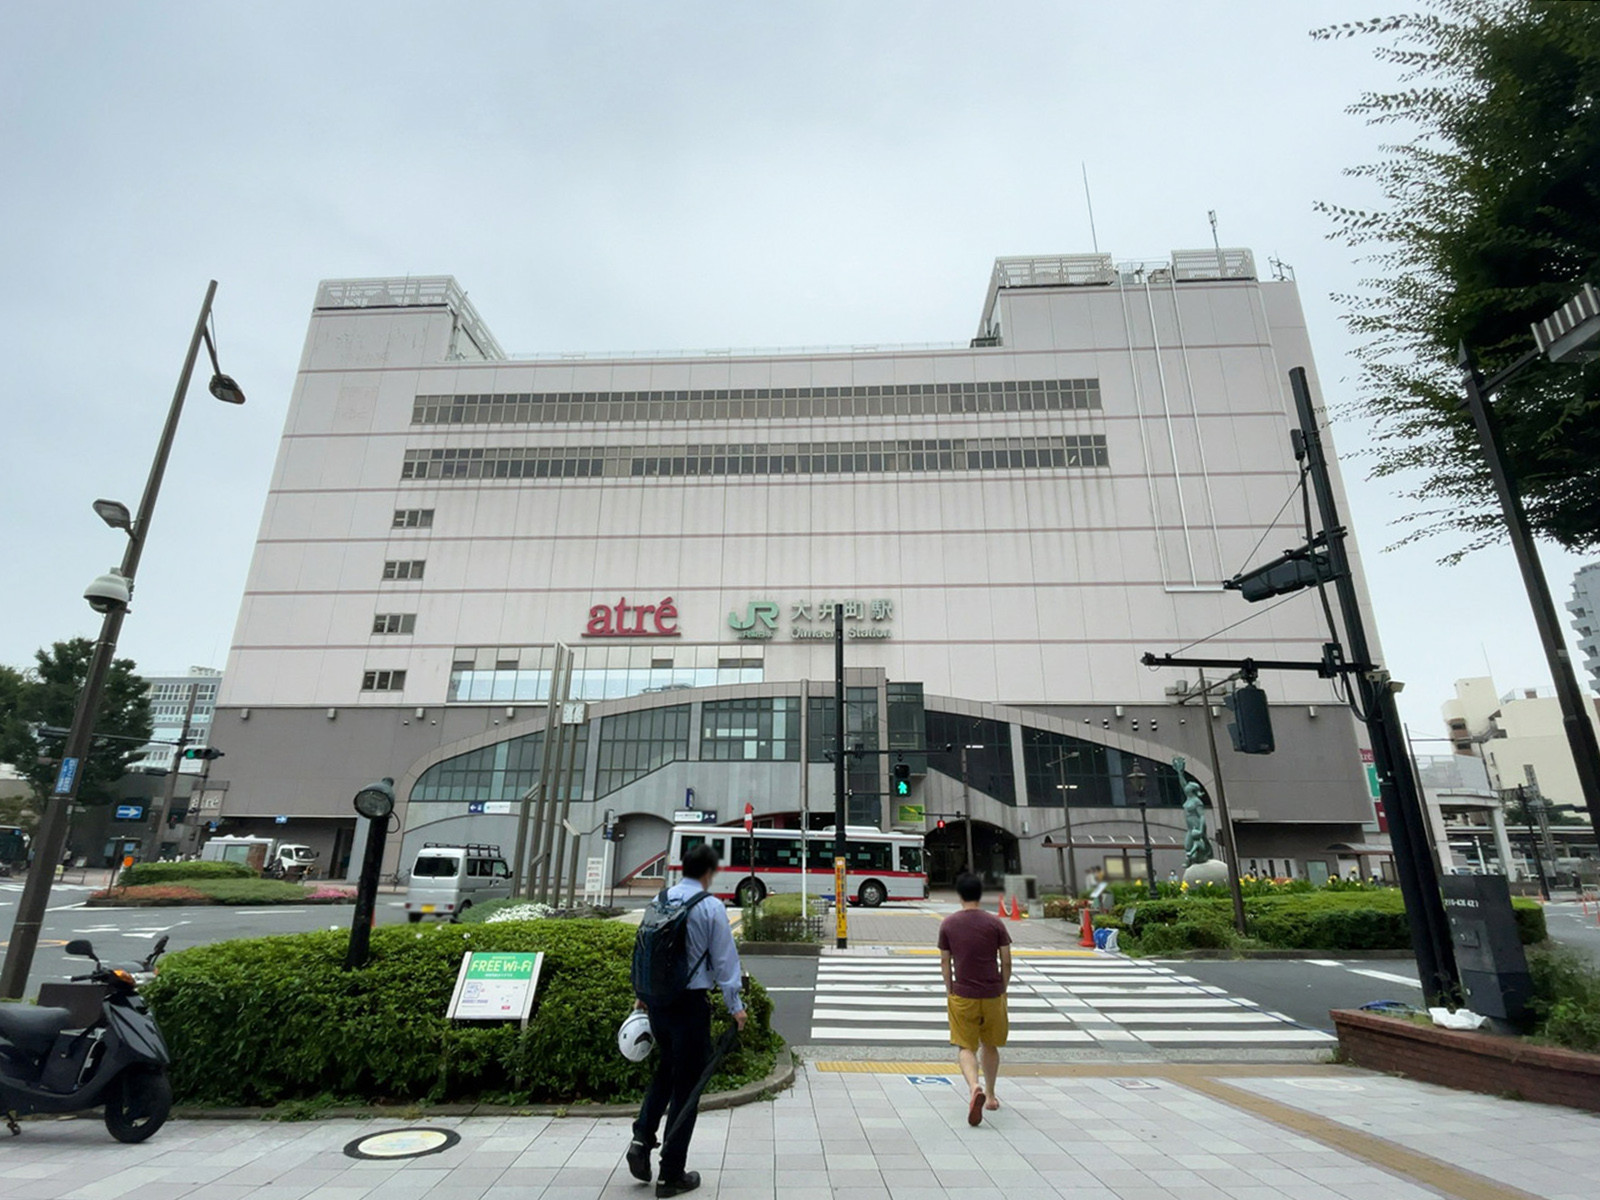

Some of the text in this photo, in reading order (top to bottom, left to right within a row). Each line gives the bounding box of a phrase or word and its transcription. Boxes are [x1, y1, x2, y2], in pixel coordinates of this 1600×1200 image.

[587, 596, 678, 635] atré
[728, 601, 780, 629] JR
[791, 600, 893, 621] 大井町駅
[848, 627, 892, 639] Station
[471, 960, 532, 972] FREE Wi-Fi
